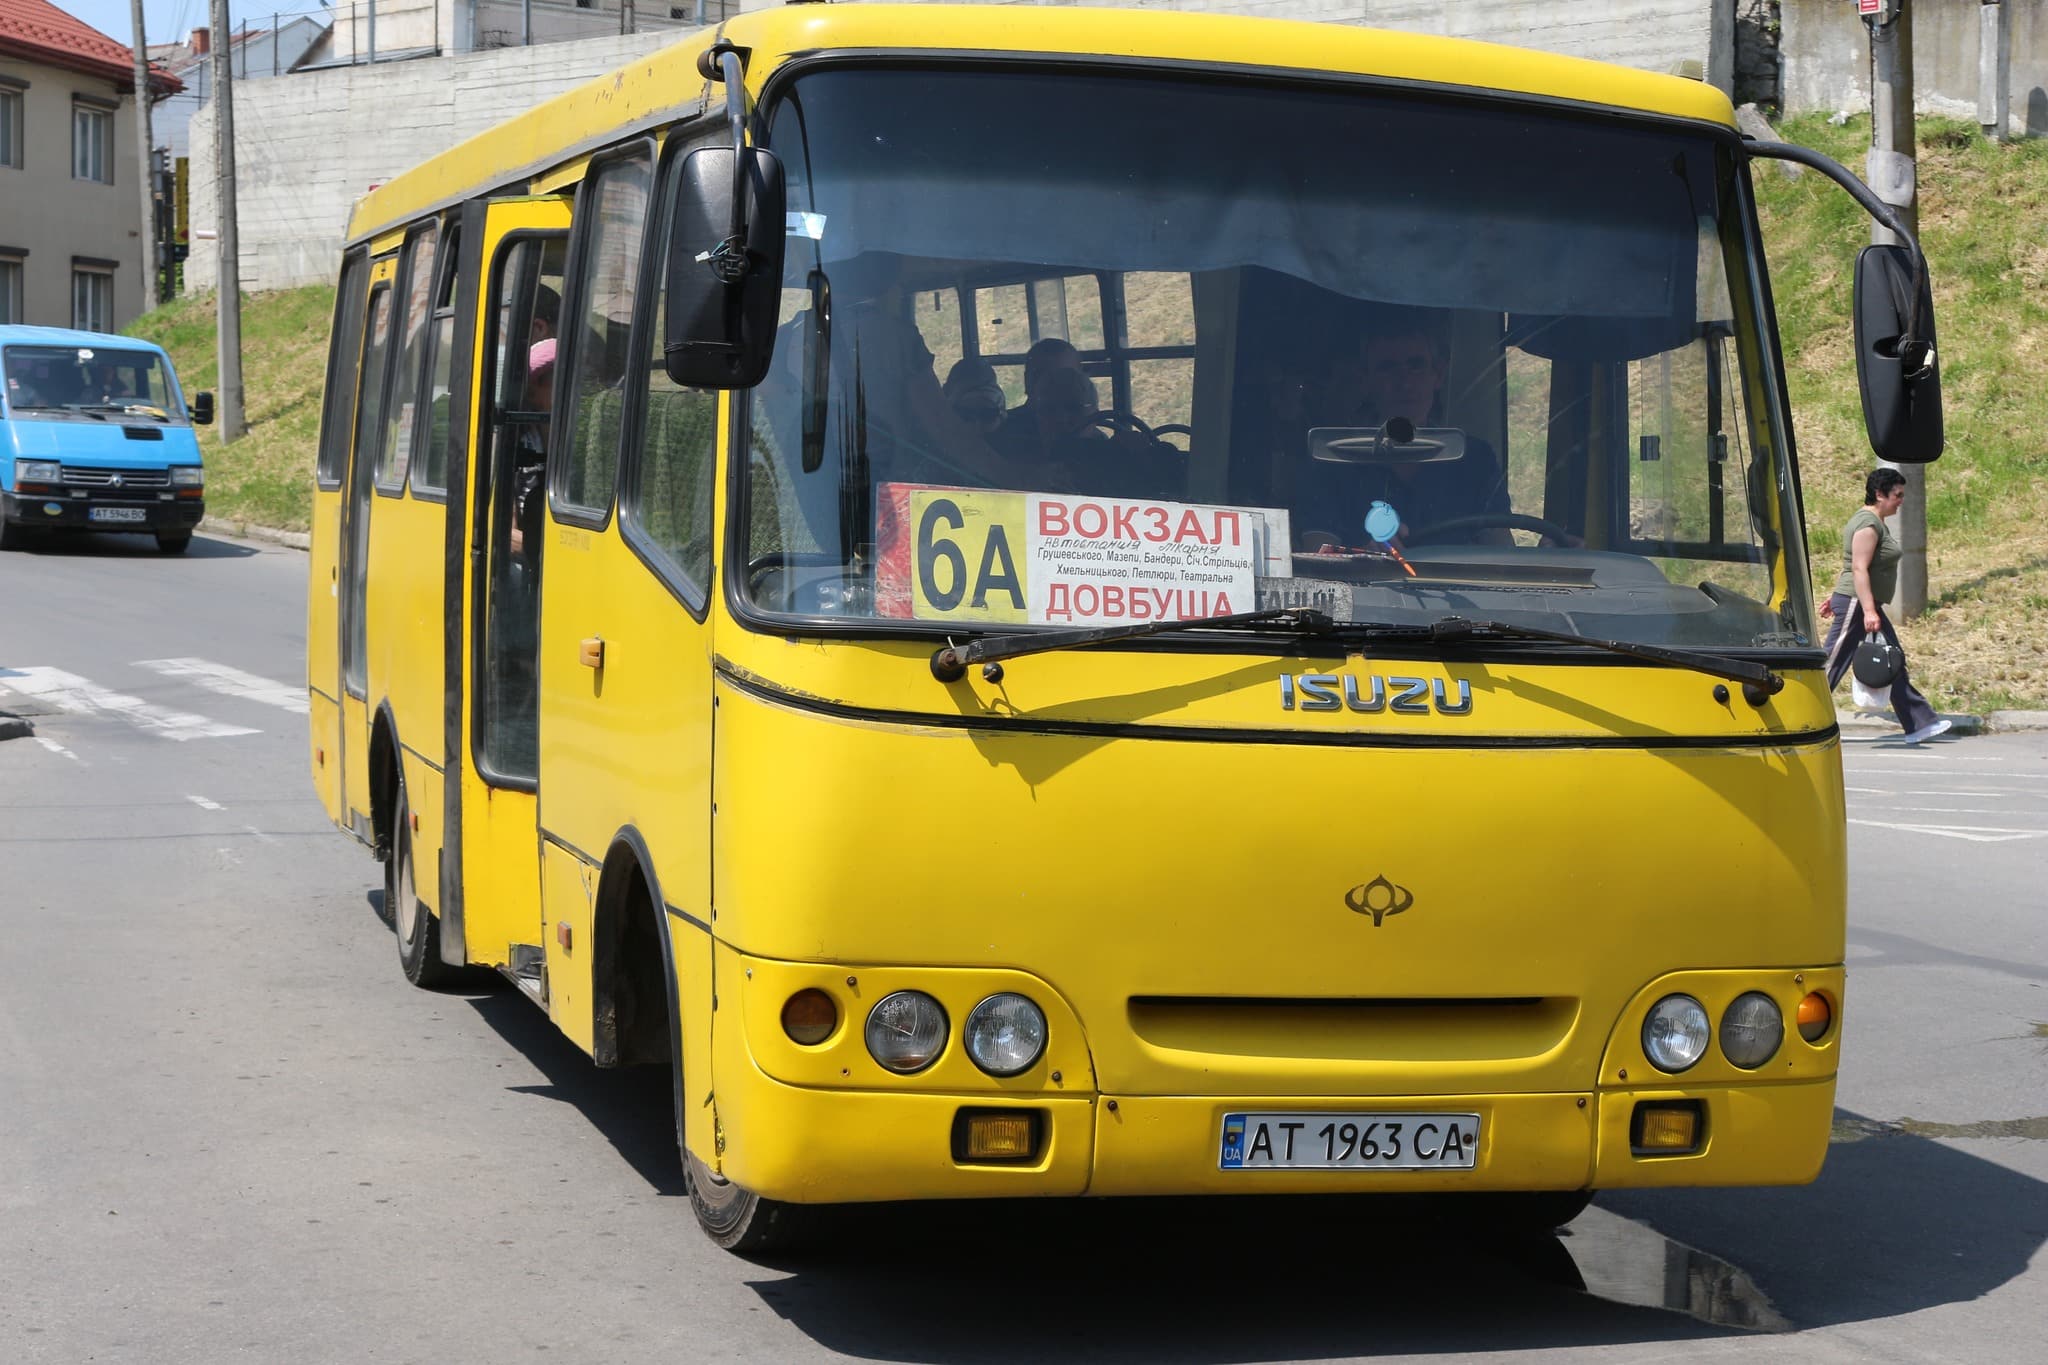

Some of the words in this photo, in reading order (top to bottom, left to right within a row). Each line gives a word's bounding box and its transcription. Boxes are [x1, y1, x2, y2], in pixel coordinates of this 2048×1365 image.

[1039, 501, 1240, 546] ВОКЗАЛ
[1037, 547, 1104, 562] Грушевського,
[1107, 551, 1142, 564] Мазепи,
[1144, 552, 1184, 567] Бандери,
[1056, 564, 1130, 579] Хмельницького,
[1132, 567, 1177, 582] Петлюри,
[1180, 569, 1234, 584] Театральна
[1046, 583, 1233, 621] ДОВБУША
[1279, 673, 1472, 714] ISUZU
[1224, 1148, 1241, 1161] UA
[1247, 1123, 1304, 1161] AT
[1318, 1123, 1402, 1161] 1963
[1413, 1123, 1464, 1161] CA
